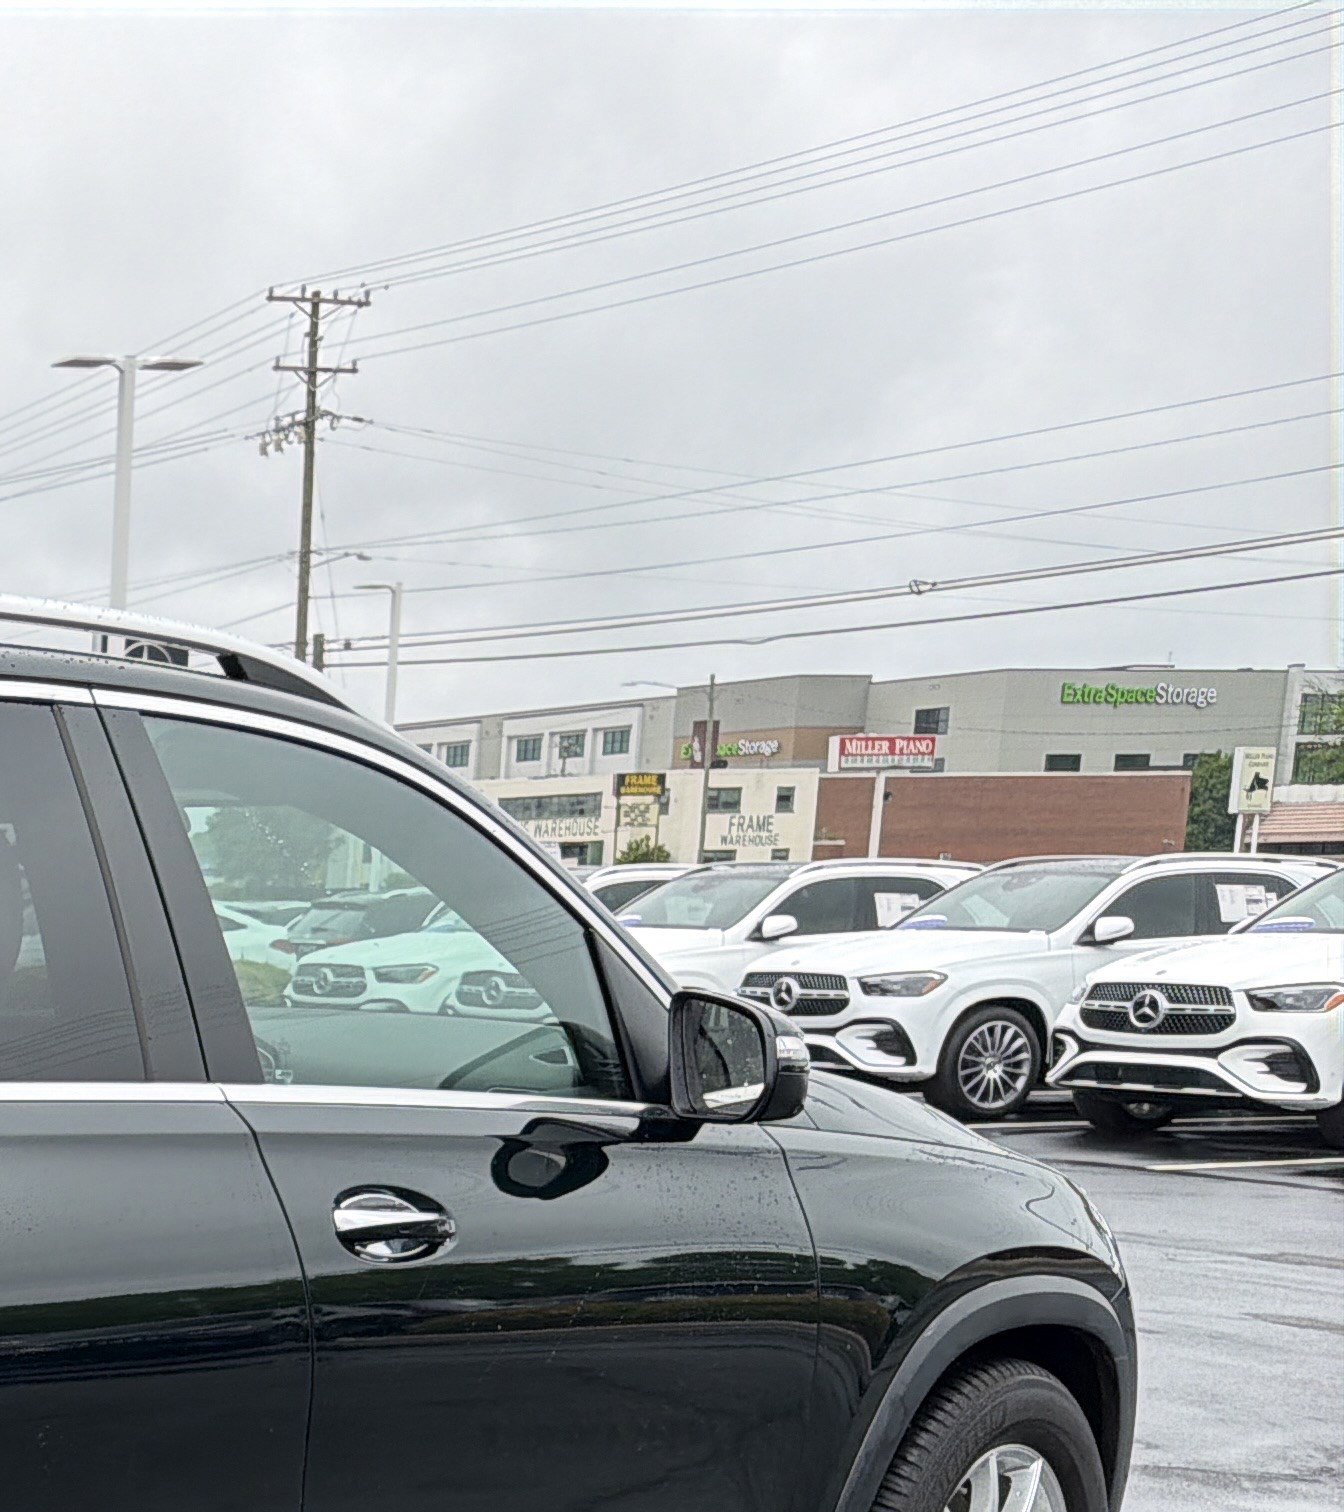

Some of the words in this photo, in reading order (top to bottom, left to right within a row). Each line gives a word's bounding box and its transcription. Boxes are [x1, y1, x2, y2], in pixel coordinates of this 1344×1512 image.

[845, 739, 890, 754] MILLER
[894, 739, 933, 754] PIANO
[625, 775, 658, 786] FRAME
[534, 816, 600, 838] WAREHOUSE
[727, 814, 775, 835] FRAME
[720, 833, 780, 847] WAREHOUSE
